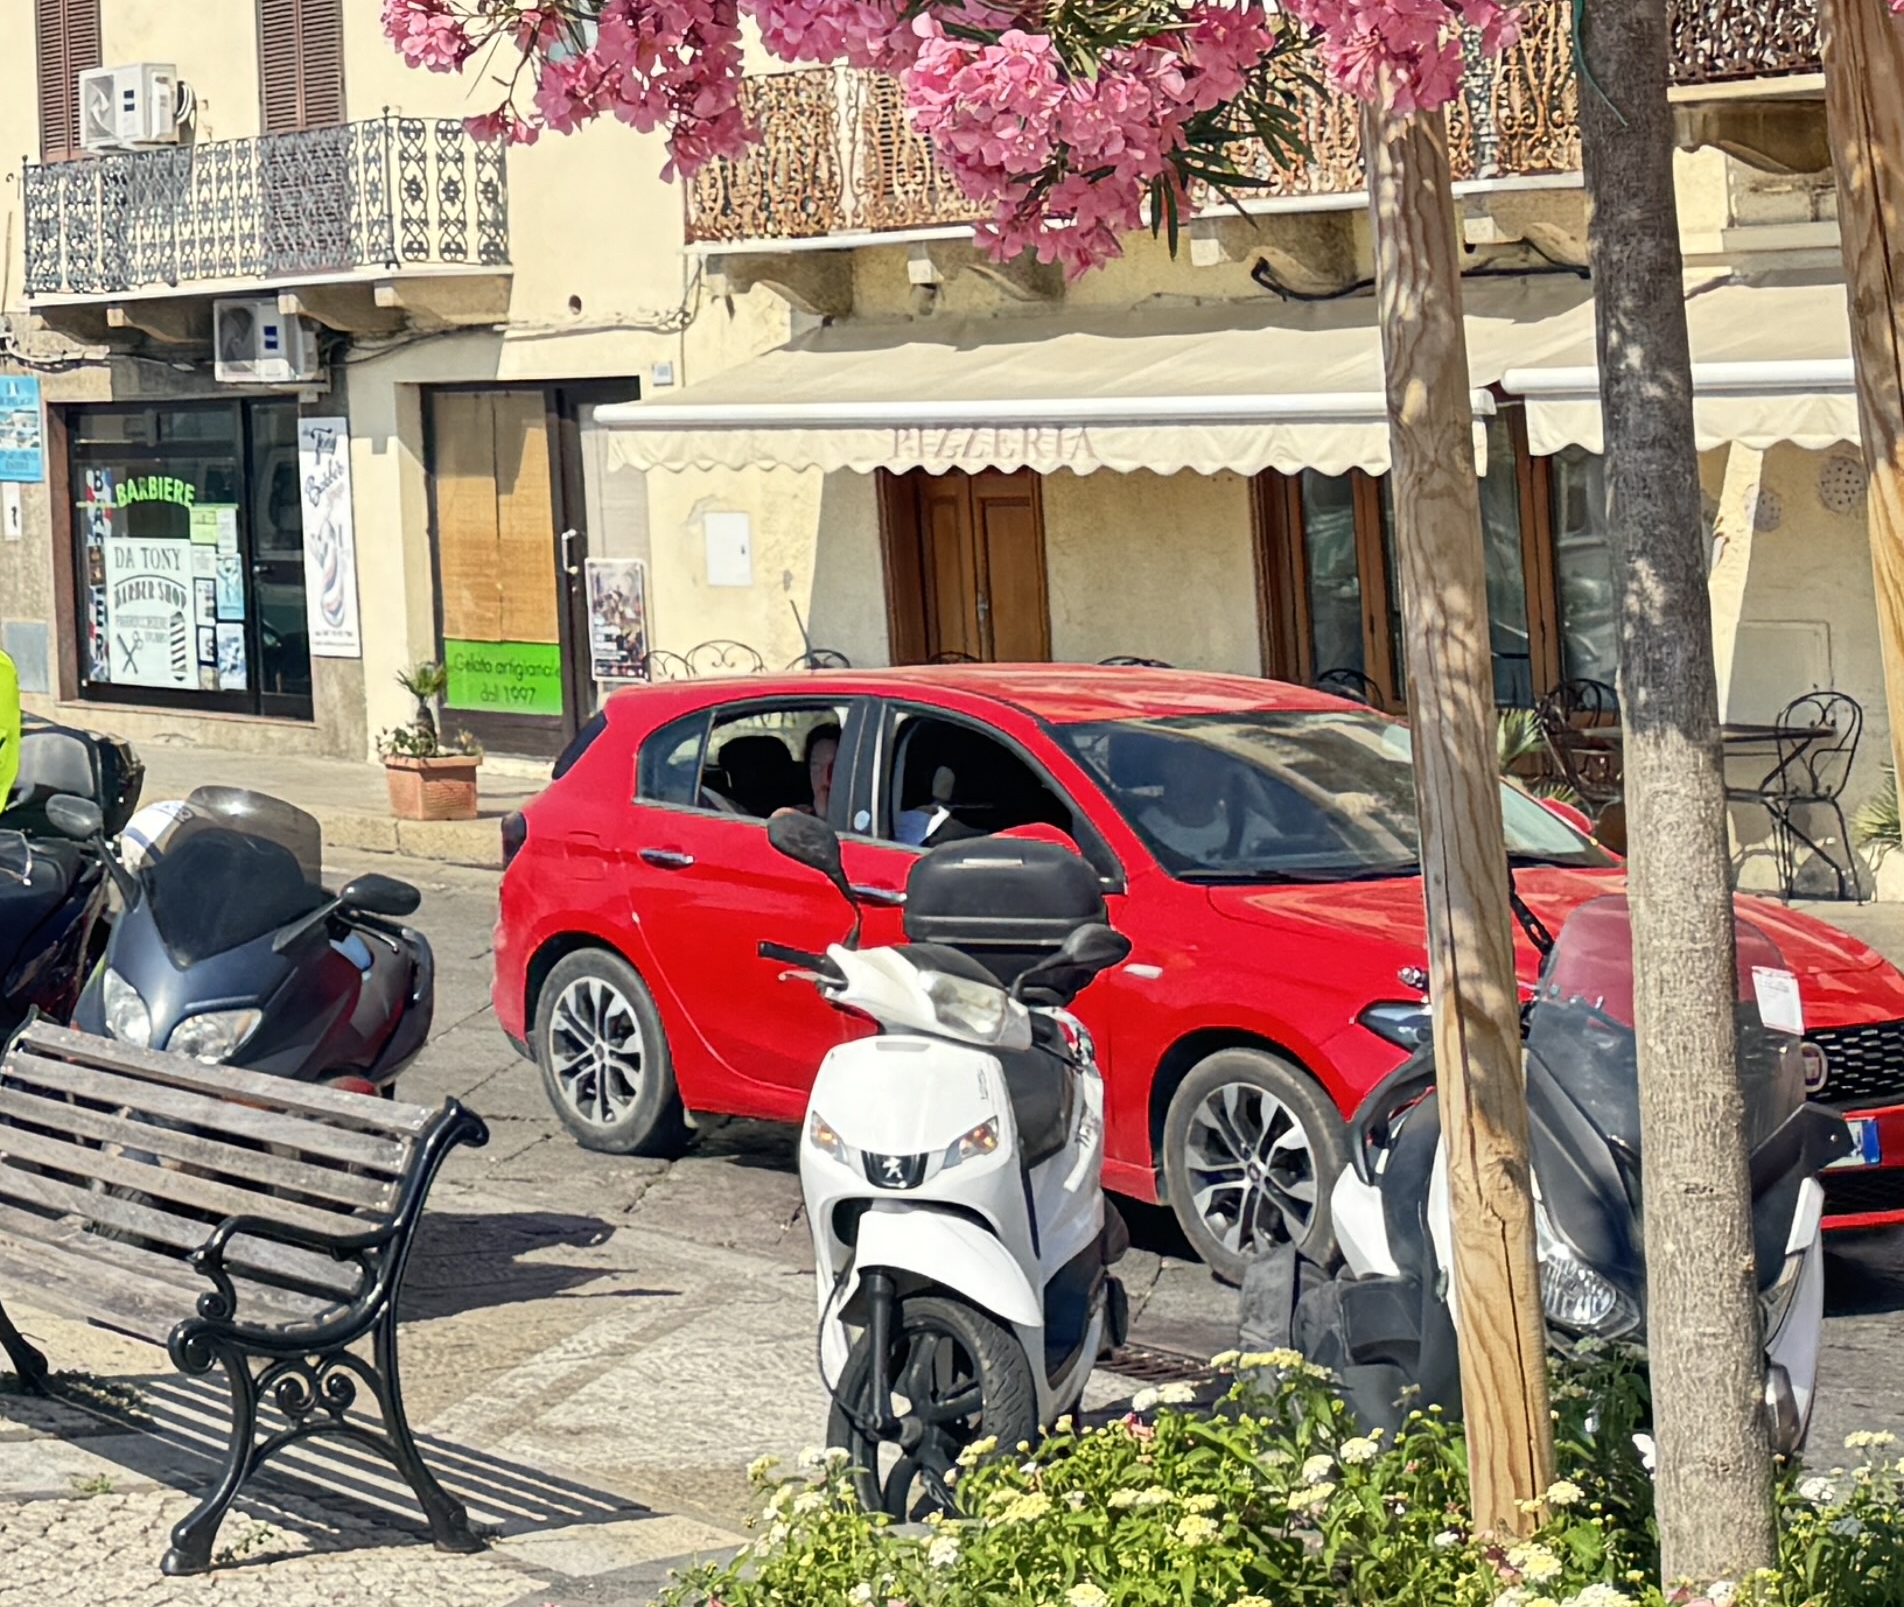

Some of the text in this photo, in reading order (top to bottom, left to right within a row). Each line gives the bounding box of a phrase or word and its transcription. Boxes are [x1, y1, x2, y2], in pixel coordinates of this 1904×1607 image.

[893, 427, 1098, 459] PIZZERIA
[115, 475, 196, 508] BARBIERE
[114, 546, 136, 569] DA
[140, 546, 182, 571] TONY
[114, 580, 155, 610] BARBER
[454, 653, 493, 674] Gelato
[503, 685, 536, 705] 1997
